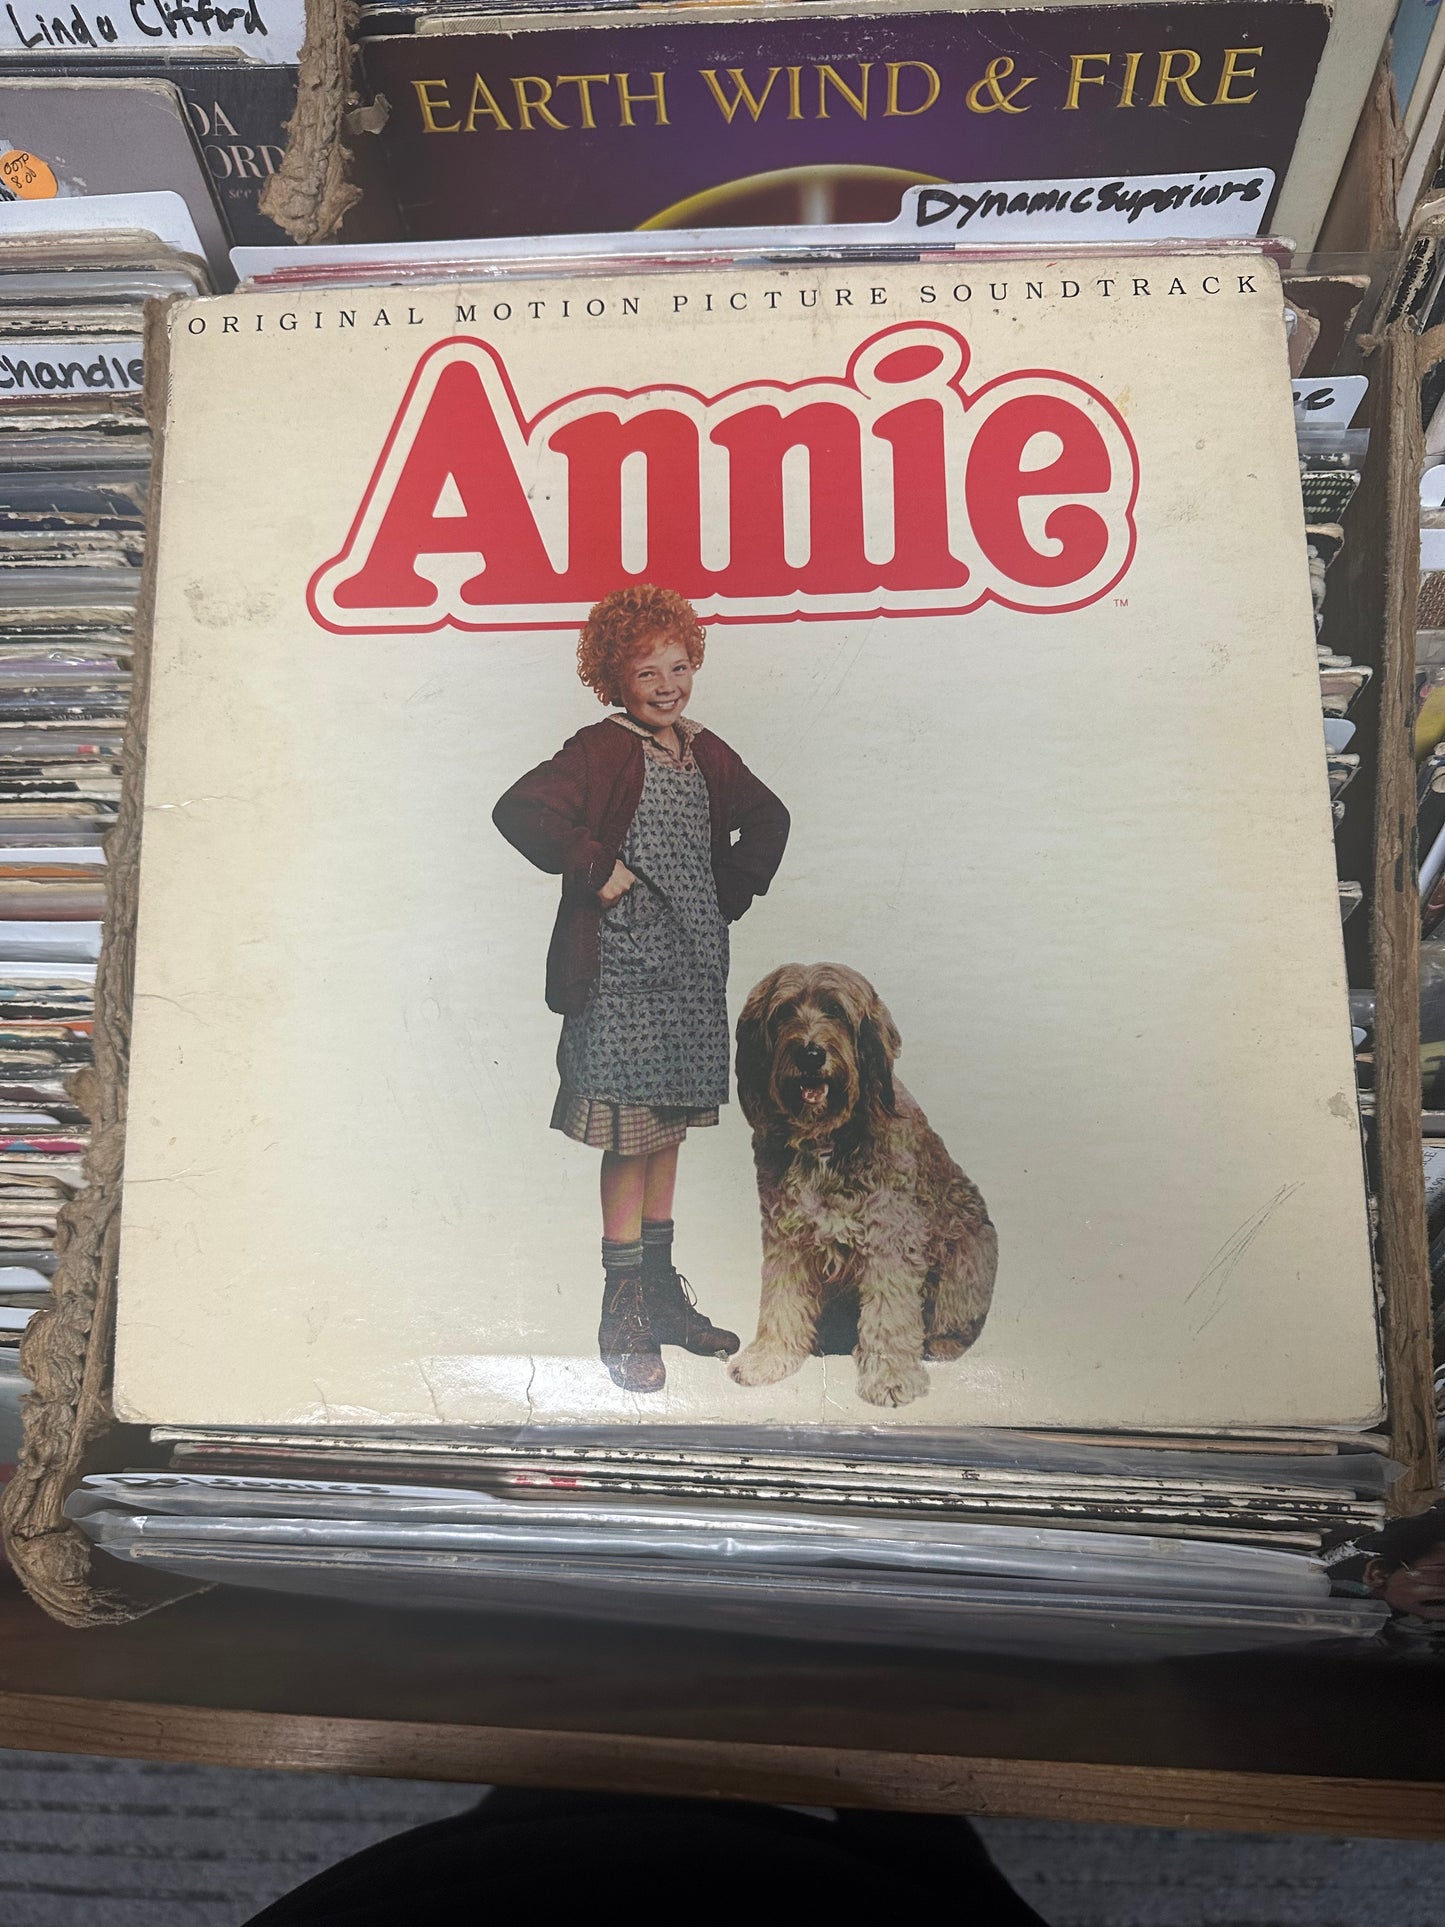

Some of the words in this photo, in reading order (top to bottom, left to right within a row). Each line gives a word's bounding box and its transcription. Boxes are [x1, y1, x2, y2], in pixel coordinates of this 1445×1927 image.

[411, 72, 672, 134] EARTH
[698, 60, 942, 125] WIND
[965, 56, 1038, 115] &
[1062, 46, 1265, 112] FIRE
[188, 307, 425, 336] ORIGINAL
[455, 298, 640, 324] MOTION
[672, 286, 888, 313] PICTURE
[919, 275, 1258, 304] SOUNDTRACK
[330, 342, 1114, 609] Annie
